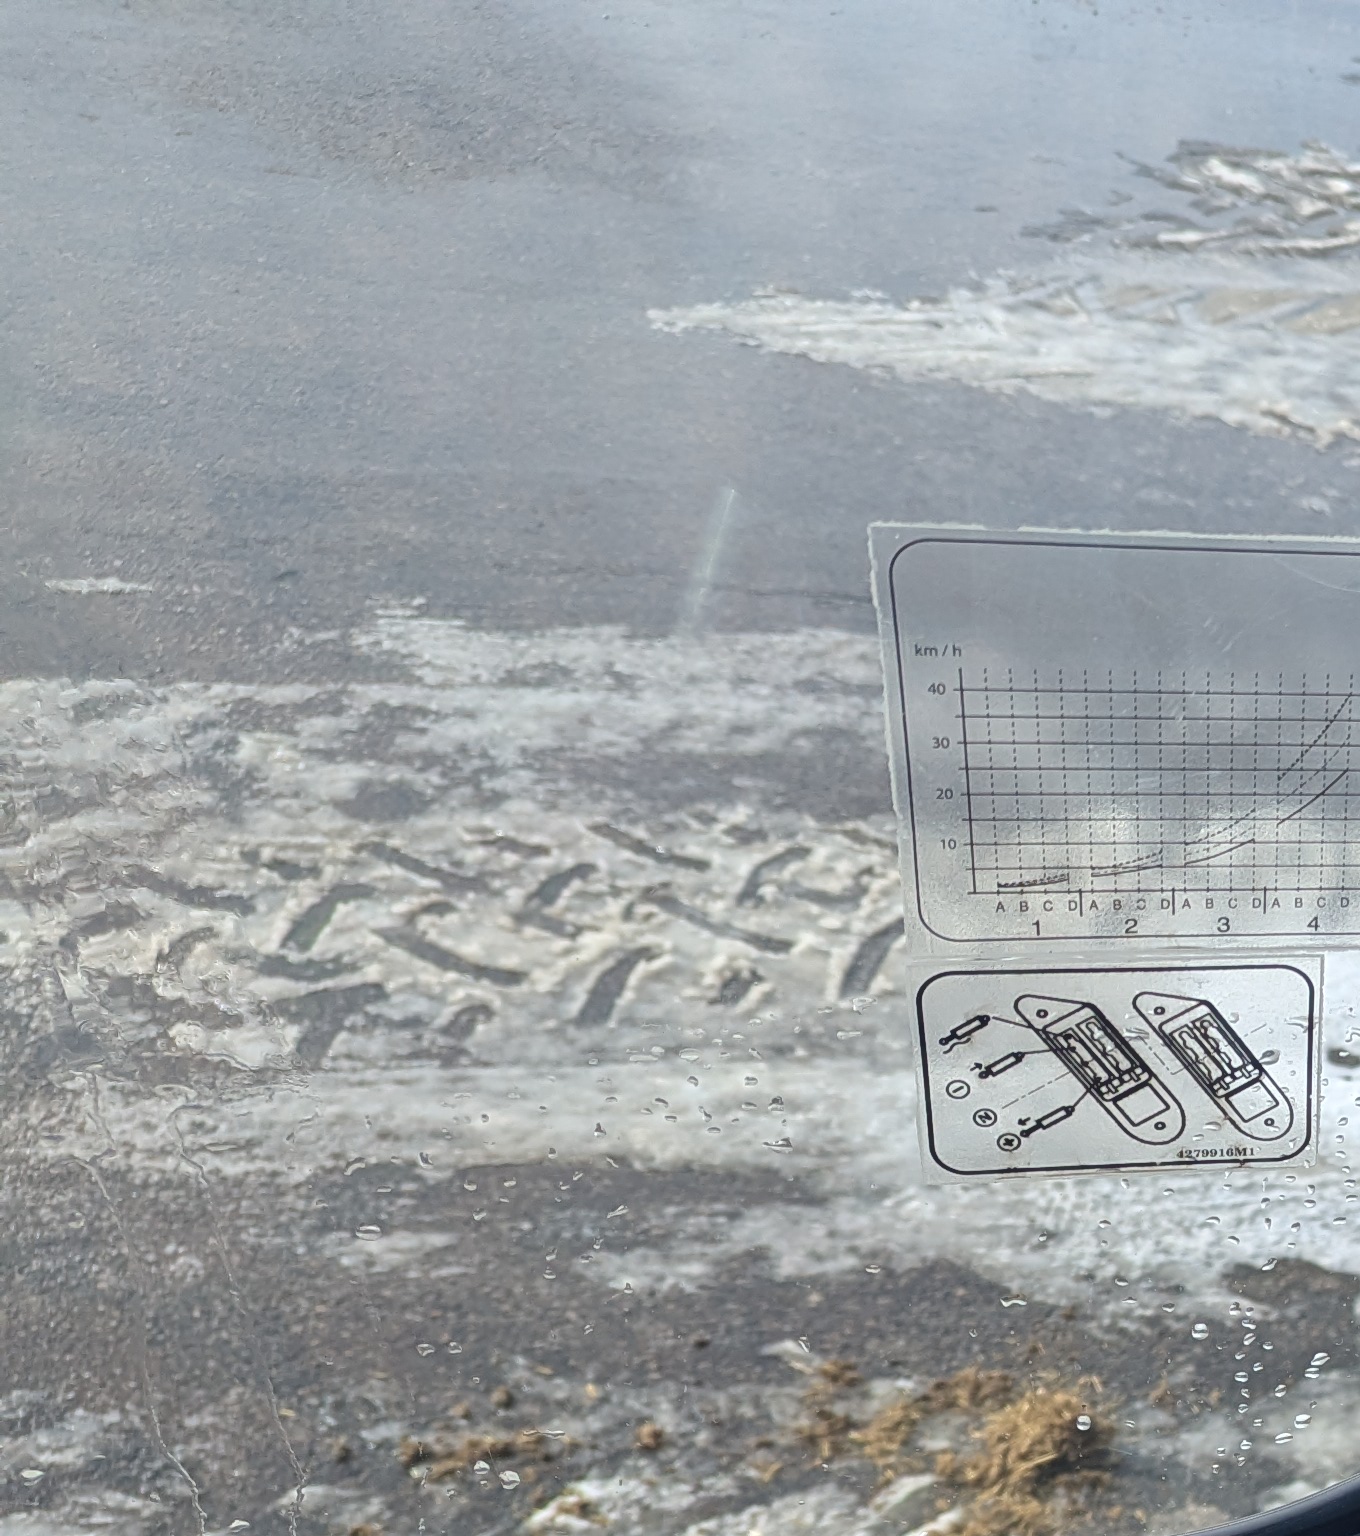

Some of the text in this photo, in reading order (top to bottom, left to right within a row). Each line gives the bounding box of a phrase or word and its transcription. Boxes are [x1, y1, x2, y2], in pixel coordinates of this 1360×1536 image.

[928, 683, 946, 695] 40
[932, 737, 950, 749] 30
[935, 788, 953, 800] 20
[940, 839, 956, 850] 10
[996, 901, 1005, 913] A
[1020, 901, 1029, 912] B
[1043, 900, 1053, 911] C
[1068, 900, 1078, 911] D
[1089, 900, 1099, 911] A
[1113, 900, 1121, 910] B
[1161, 900, 1170, 910] D
[1182, 899, 1191, 909] A
[1205, 899, 1213, 909] B
[1228, 899, 1237, 909] C
[1253, 898, 1261, 909] D
[1271, 898, 1280, 909] A
[1295, 898, 1303, 908] B
[1317, 898, 1326, 908] C
[1341, 897, 1349, 908] D
[1033, 916, 1320, 936] 1 2 3 4
[1177, 1147, 1255, 1158] 4279916M1
